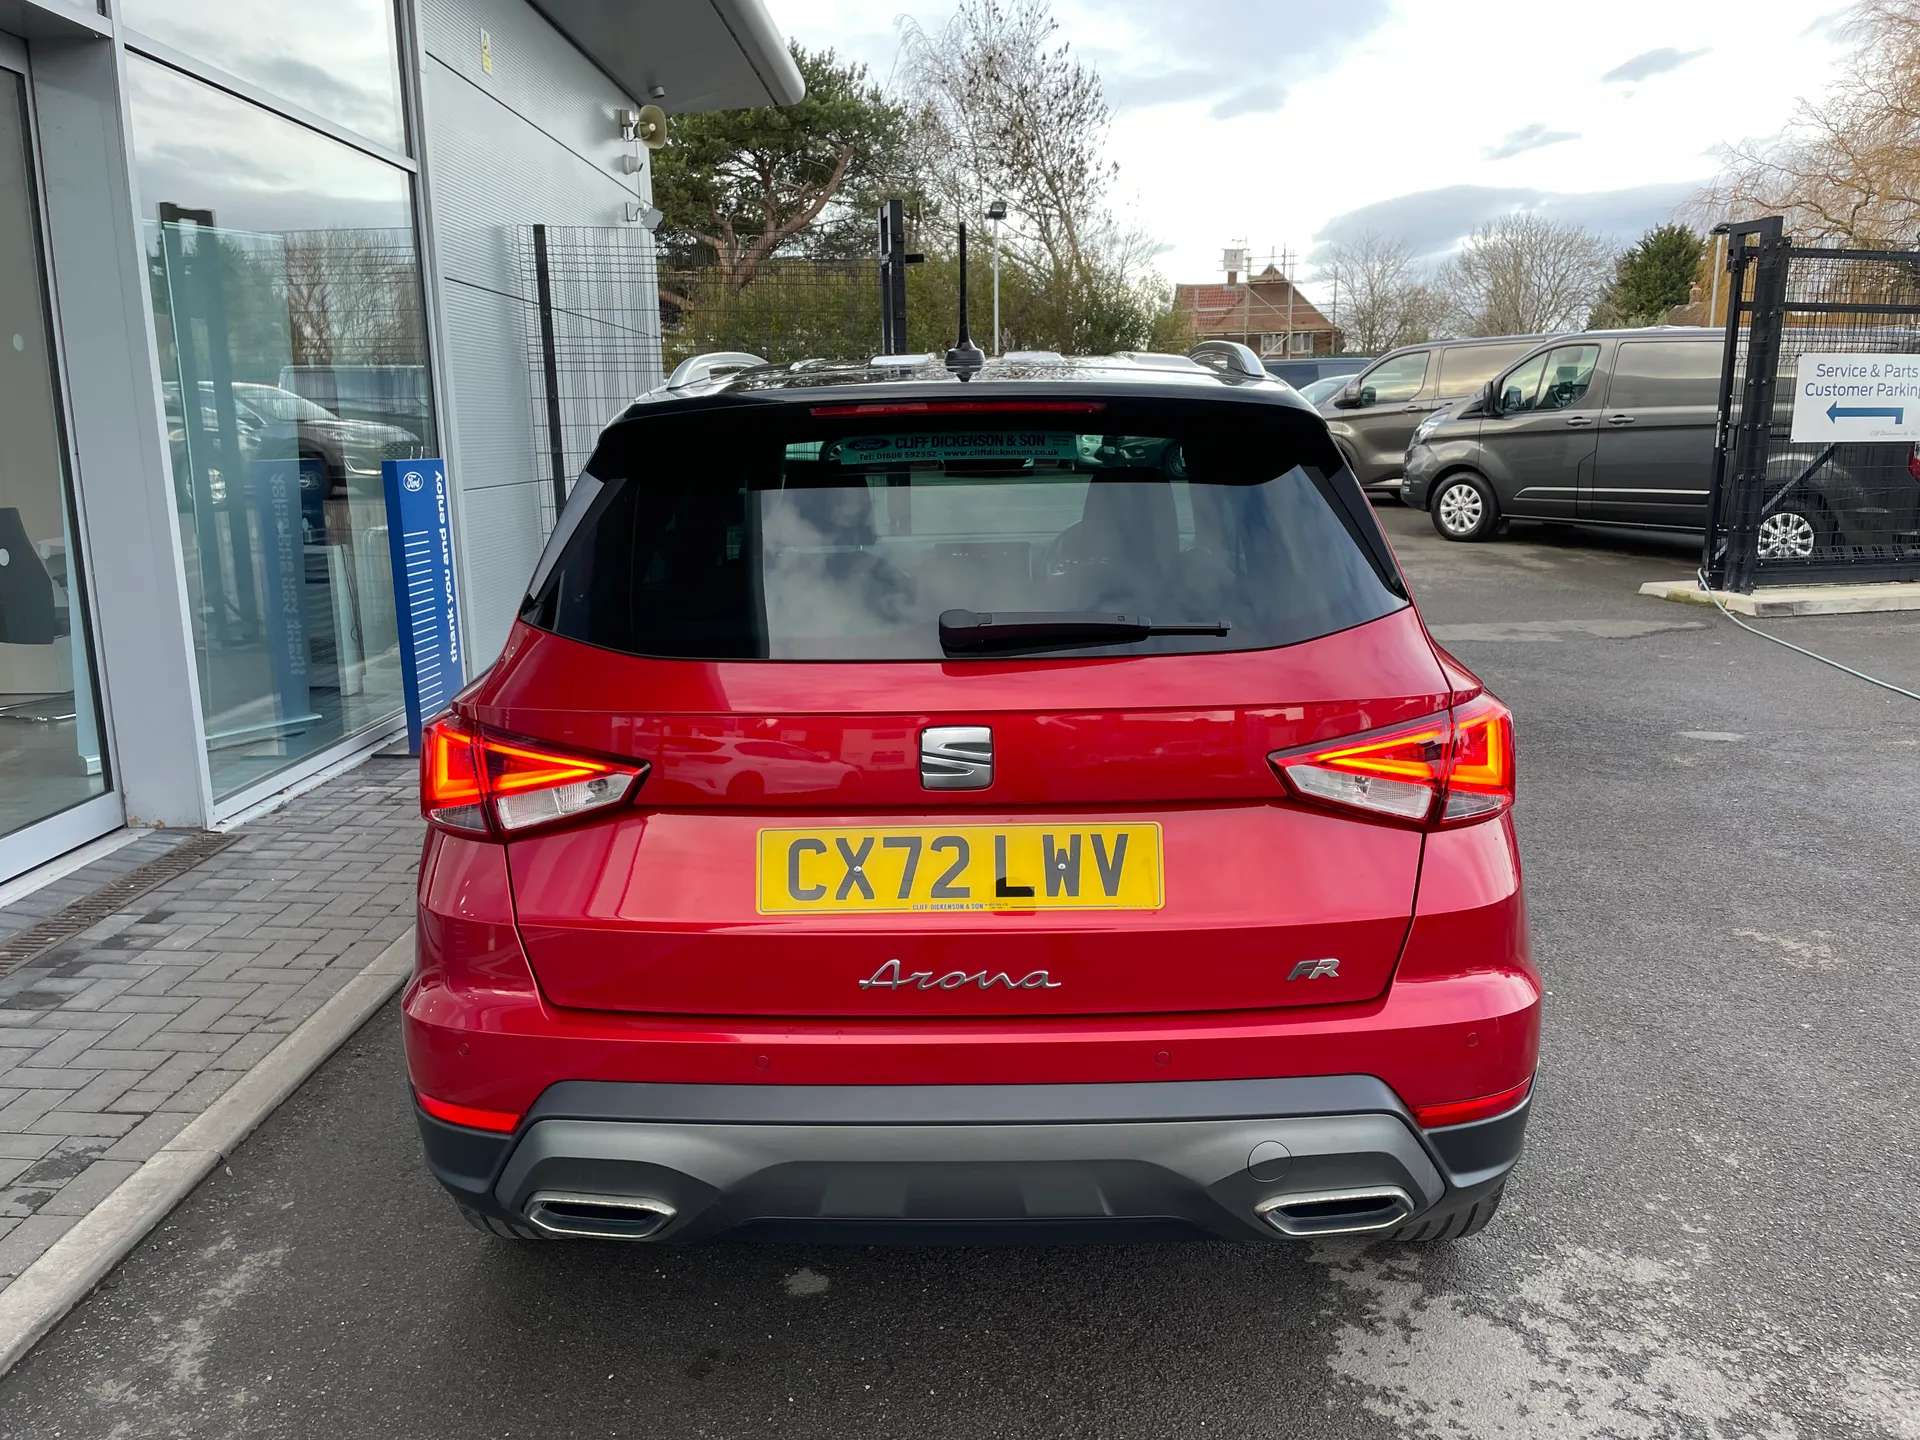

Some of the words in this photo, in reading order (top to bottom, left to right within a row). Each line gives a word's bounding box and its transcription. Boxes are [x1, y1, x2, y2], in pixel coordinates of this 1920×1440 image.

[1816, 363, 1867, 378] Service
[1870, 363, 1881, 378] &
[1884, 364, 1919, 378] Parts
[1804, 382, 1874, 397] Customer
[1876, 383, 1920, 399] Parkin
[895, 436, 928, 449] CLIFF
[931, 434, 1003, 448] DICKENSON
[1006, 434, 1017, 447] &
[1019, 434, 1045, 447] SON
[406, 474, 421, 489] Ford
[434, 470, 446, 524] enjoy
[439, 528, 449, 566] and
[444, 569, 454, 605] you
[447, 607, 458, 664] thank
[787, 835, 971, 901] CX72
[994, 833, 1129, 898] LWV
[912, 903, 928, 911] CLIFF
[930, 903, 965, 911] DICKENSON
[858, 959, 1062, 991] Arona
[1286, 958, 1341, 981] FR
